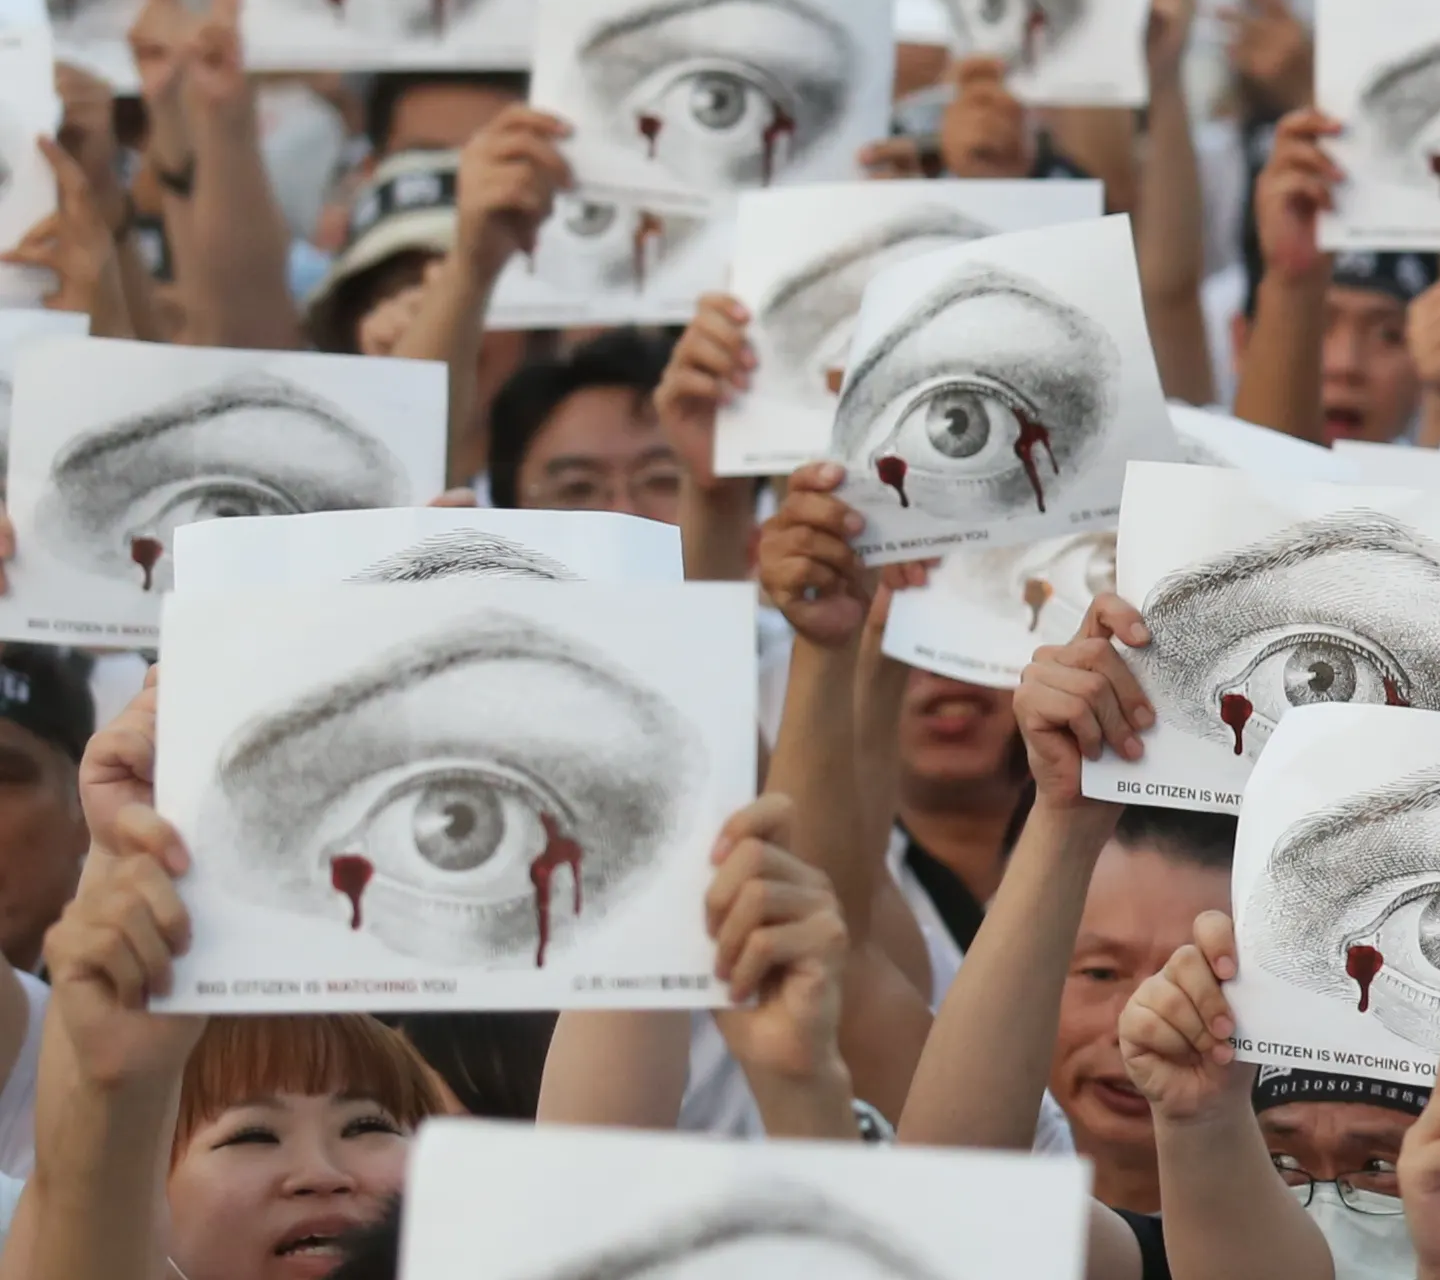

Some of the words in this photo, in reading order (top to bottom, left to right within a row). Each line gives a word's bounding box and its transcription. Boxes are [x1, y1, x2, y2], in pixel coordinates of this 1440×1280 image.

[1117, 780, 1141, 795] BIG
[1145, 783, 1197, 800] CITIZEN
[1200, 789, 1212, 802] IS
[1230, 1037, 1253, 1051] BIG
[1257, 1041, 1313, 1060] CITIZEN
[1317, 1049, 1330, 1062] IS
[1333, 1052, 1410, 1073] WATCHING
[1413, 1062, 1438, 1077] YOU
